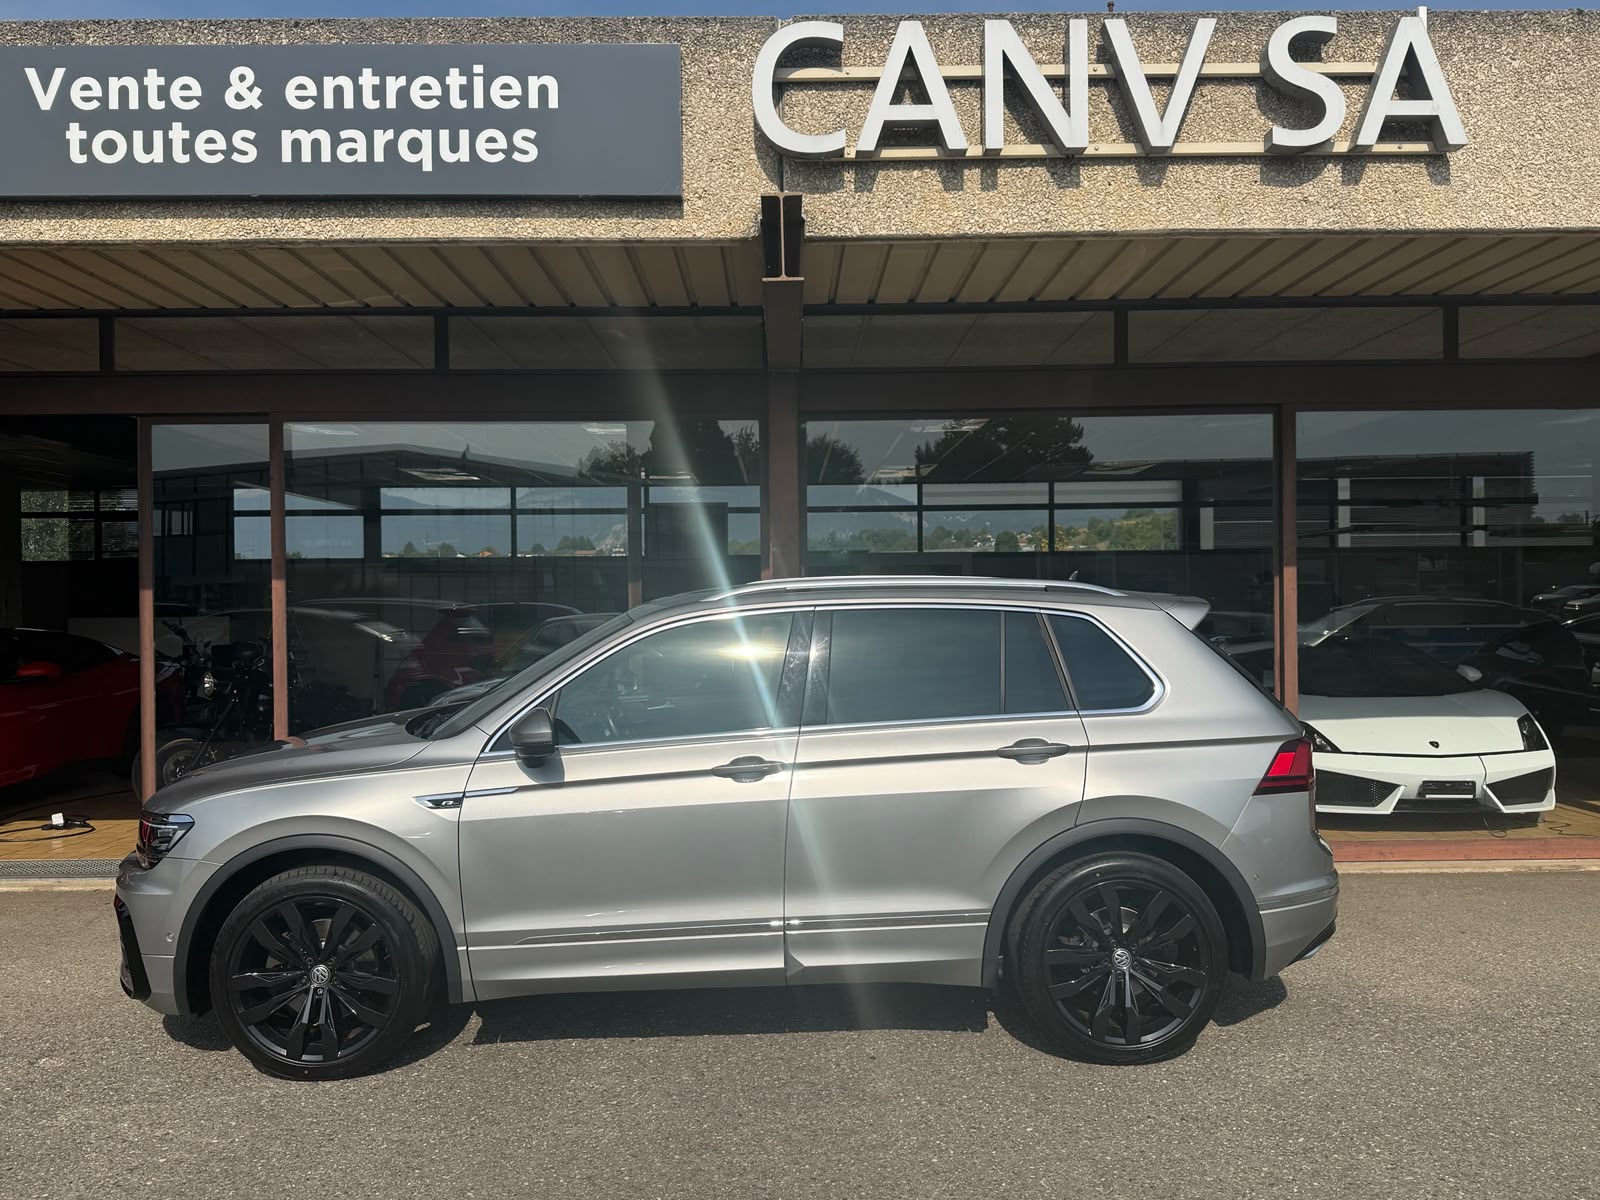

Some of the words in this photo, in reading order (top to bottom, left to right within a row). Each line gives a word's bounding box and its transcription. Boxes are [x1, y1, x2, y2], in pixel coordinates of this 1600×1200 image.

[23, 67, 203, 111] Vente
[224, 65, 264, 110] &
[284, 64, 559, 110] entretien
[752, 18, 1216, 155] CANV
[1265, 15, 1467, 153] SA
[65, 121, 258, 165] toutes
[281, 128, 539, 172] marques
